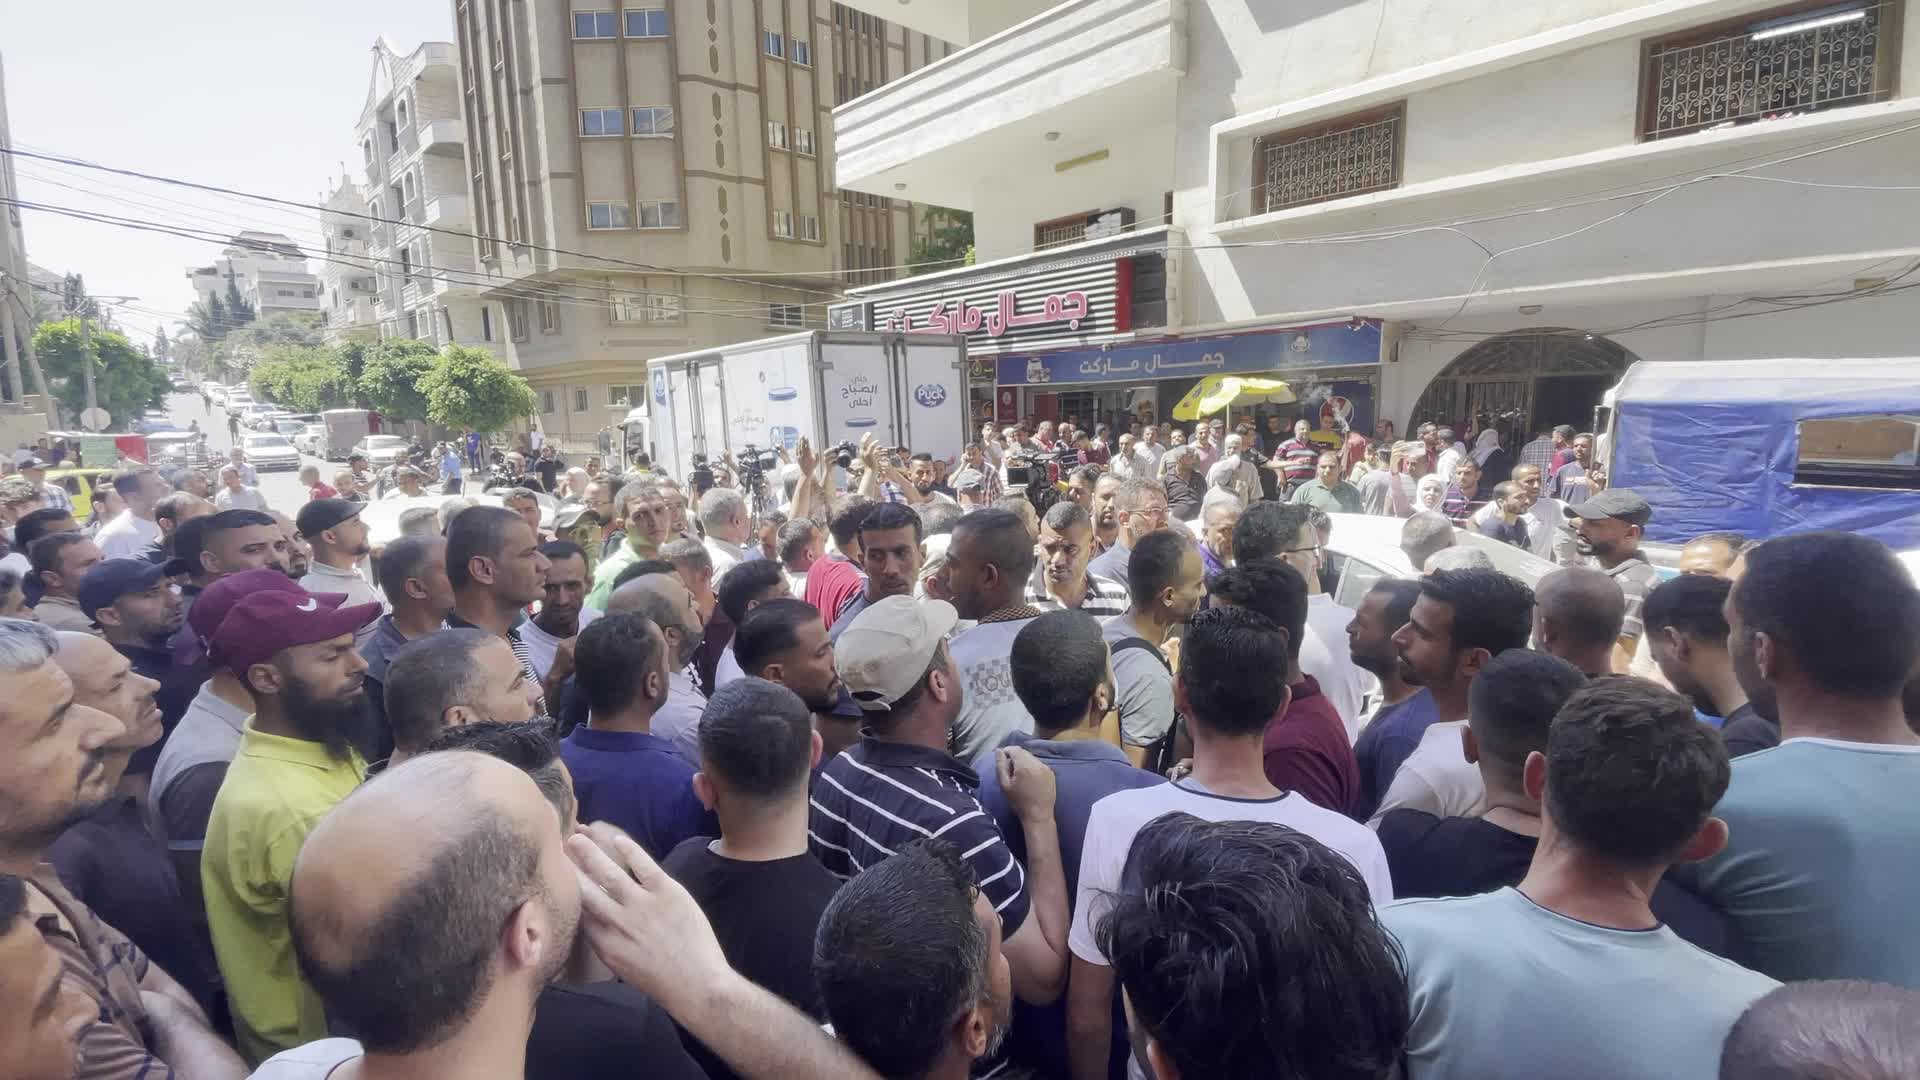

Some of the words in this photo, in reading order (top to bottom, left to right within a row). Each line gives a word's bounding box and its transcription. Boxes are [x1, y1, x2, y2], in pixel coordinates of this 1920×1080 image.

[986, 290, 1089, 337] جمال
[1079, 357, 1140, 375] ماركت
[1144, 351, 1225, 373] جمال
[841, 384, 878, 399] الصباح
